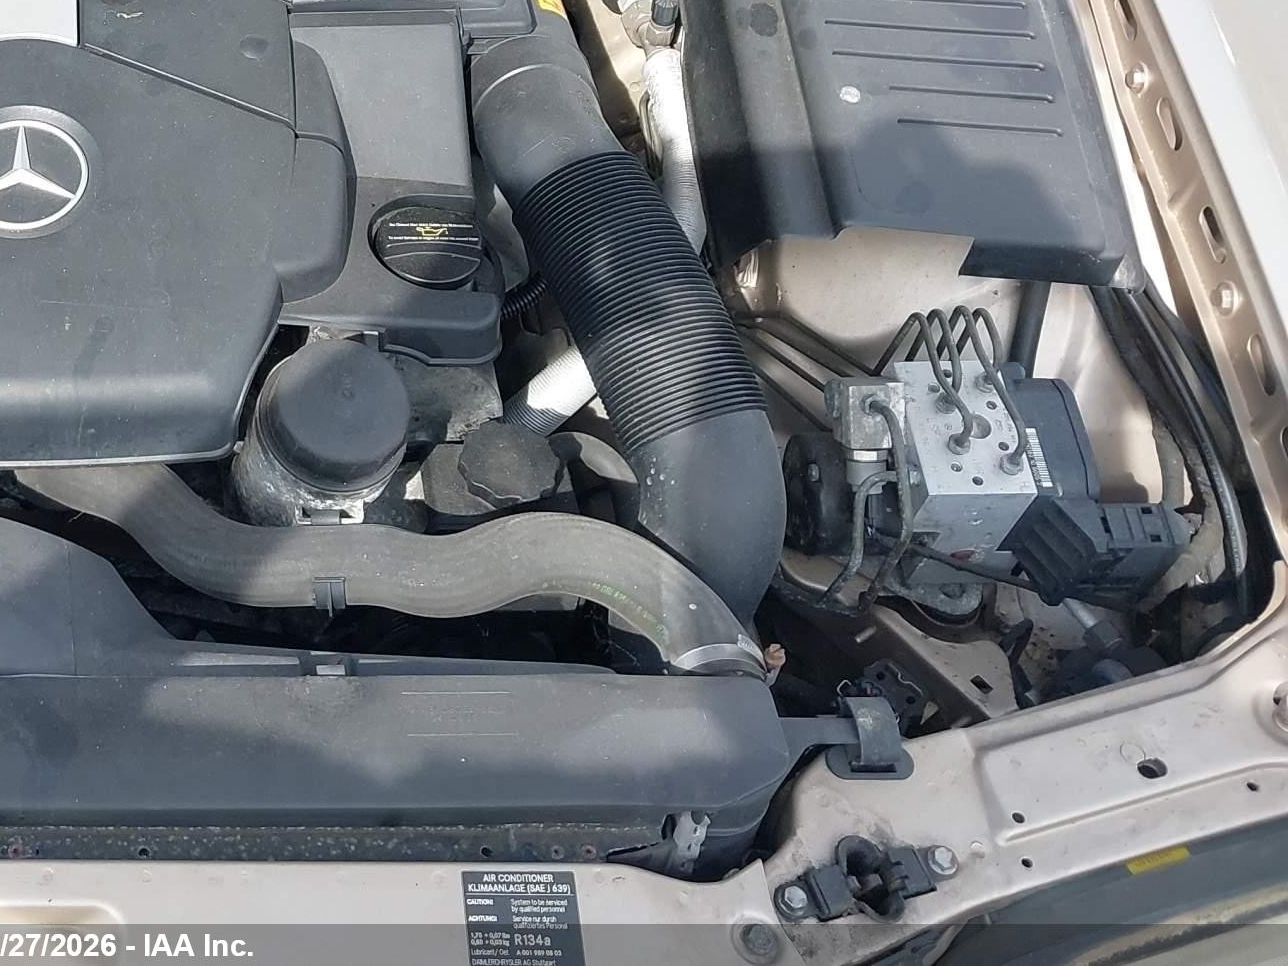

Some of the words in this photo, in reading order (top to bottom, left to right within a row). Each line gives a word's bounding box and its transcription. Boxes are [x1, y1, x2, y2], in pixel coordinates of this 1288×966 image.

[483, 874, 497, 883] AIR
[498, 874, 554, 883] CONDITIONER
[468, 883, 526, 893] KLIMAANLAGE
[527, 883, 545, 895] (SAE
[552, 883, 571, 895] 639)
[510, 898, 531, 907] System
[546, 898, 568, 906] serviced
[519, 906, 540, 914] qualified
[512, 915, 531, 923] Service
[514, 933, 552, 946] R134a
